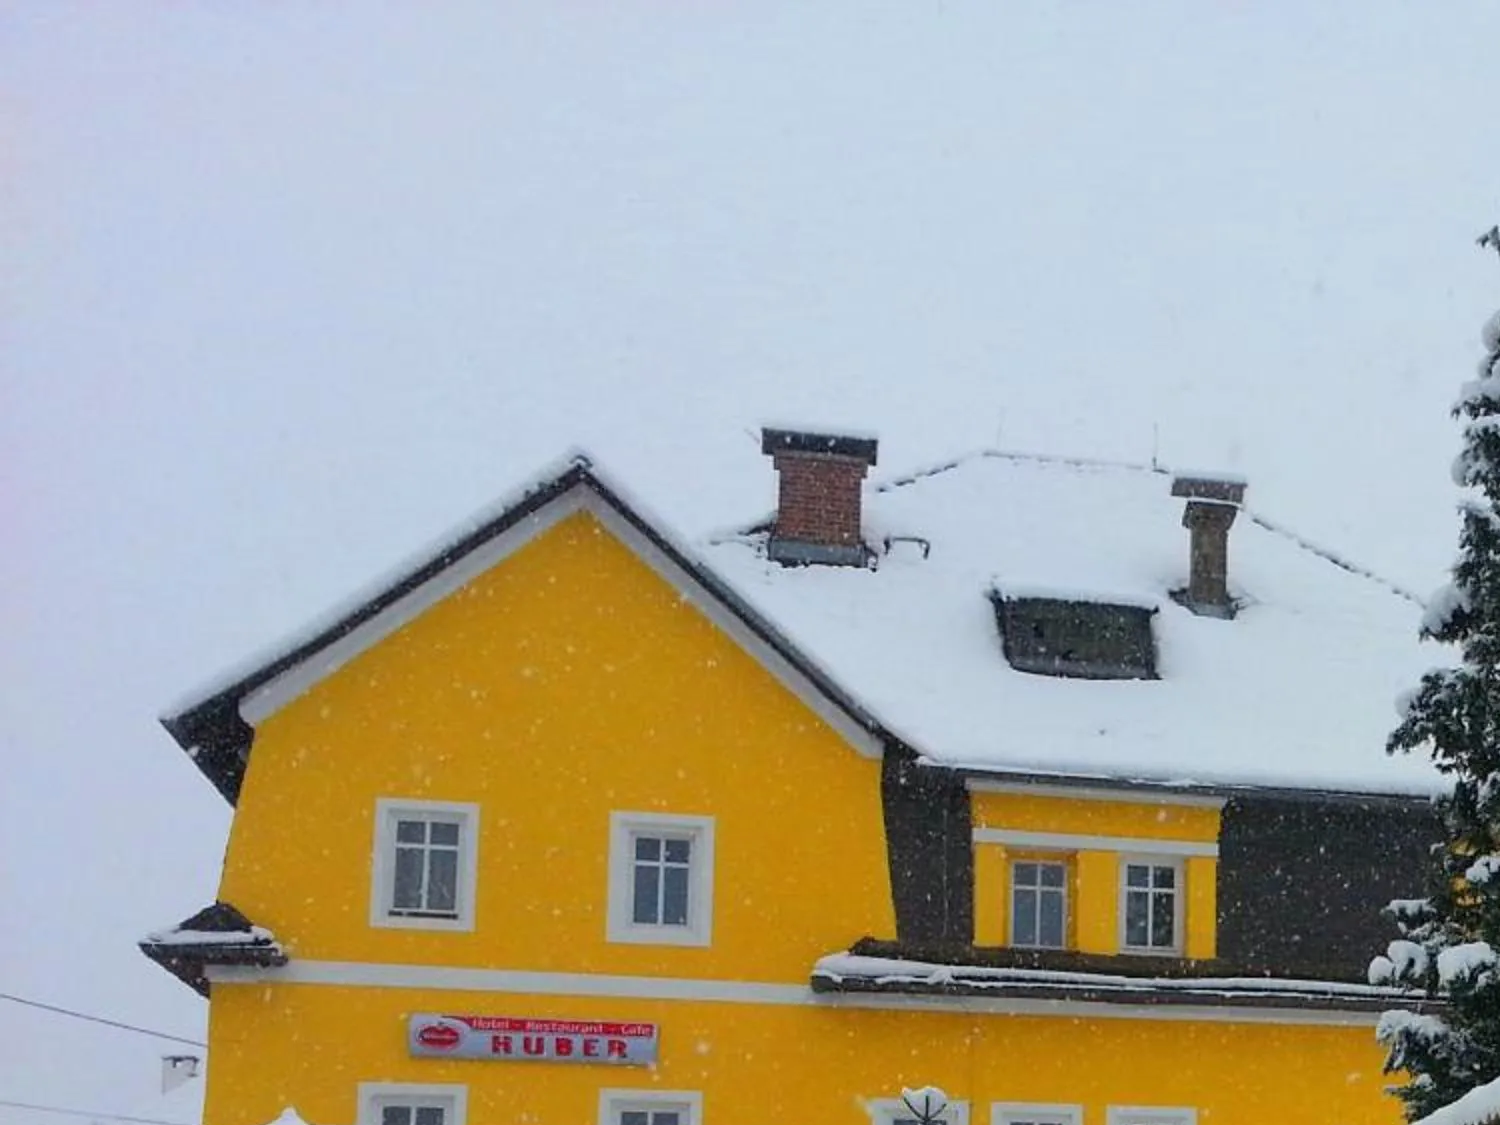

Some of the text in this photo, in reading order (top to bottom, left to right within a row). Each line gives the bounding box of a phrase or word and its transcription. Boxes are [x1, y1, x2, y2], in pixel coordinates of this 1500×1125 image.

[472, 1016, 510, 1030] Hotel
[525, 1020, 603, 1034] Restaurant
[492, 1035, 628, 1058] HUBER
